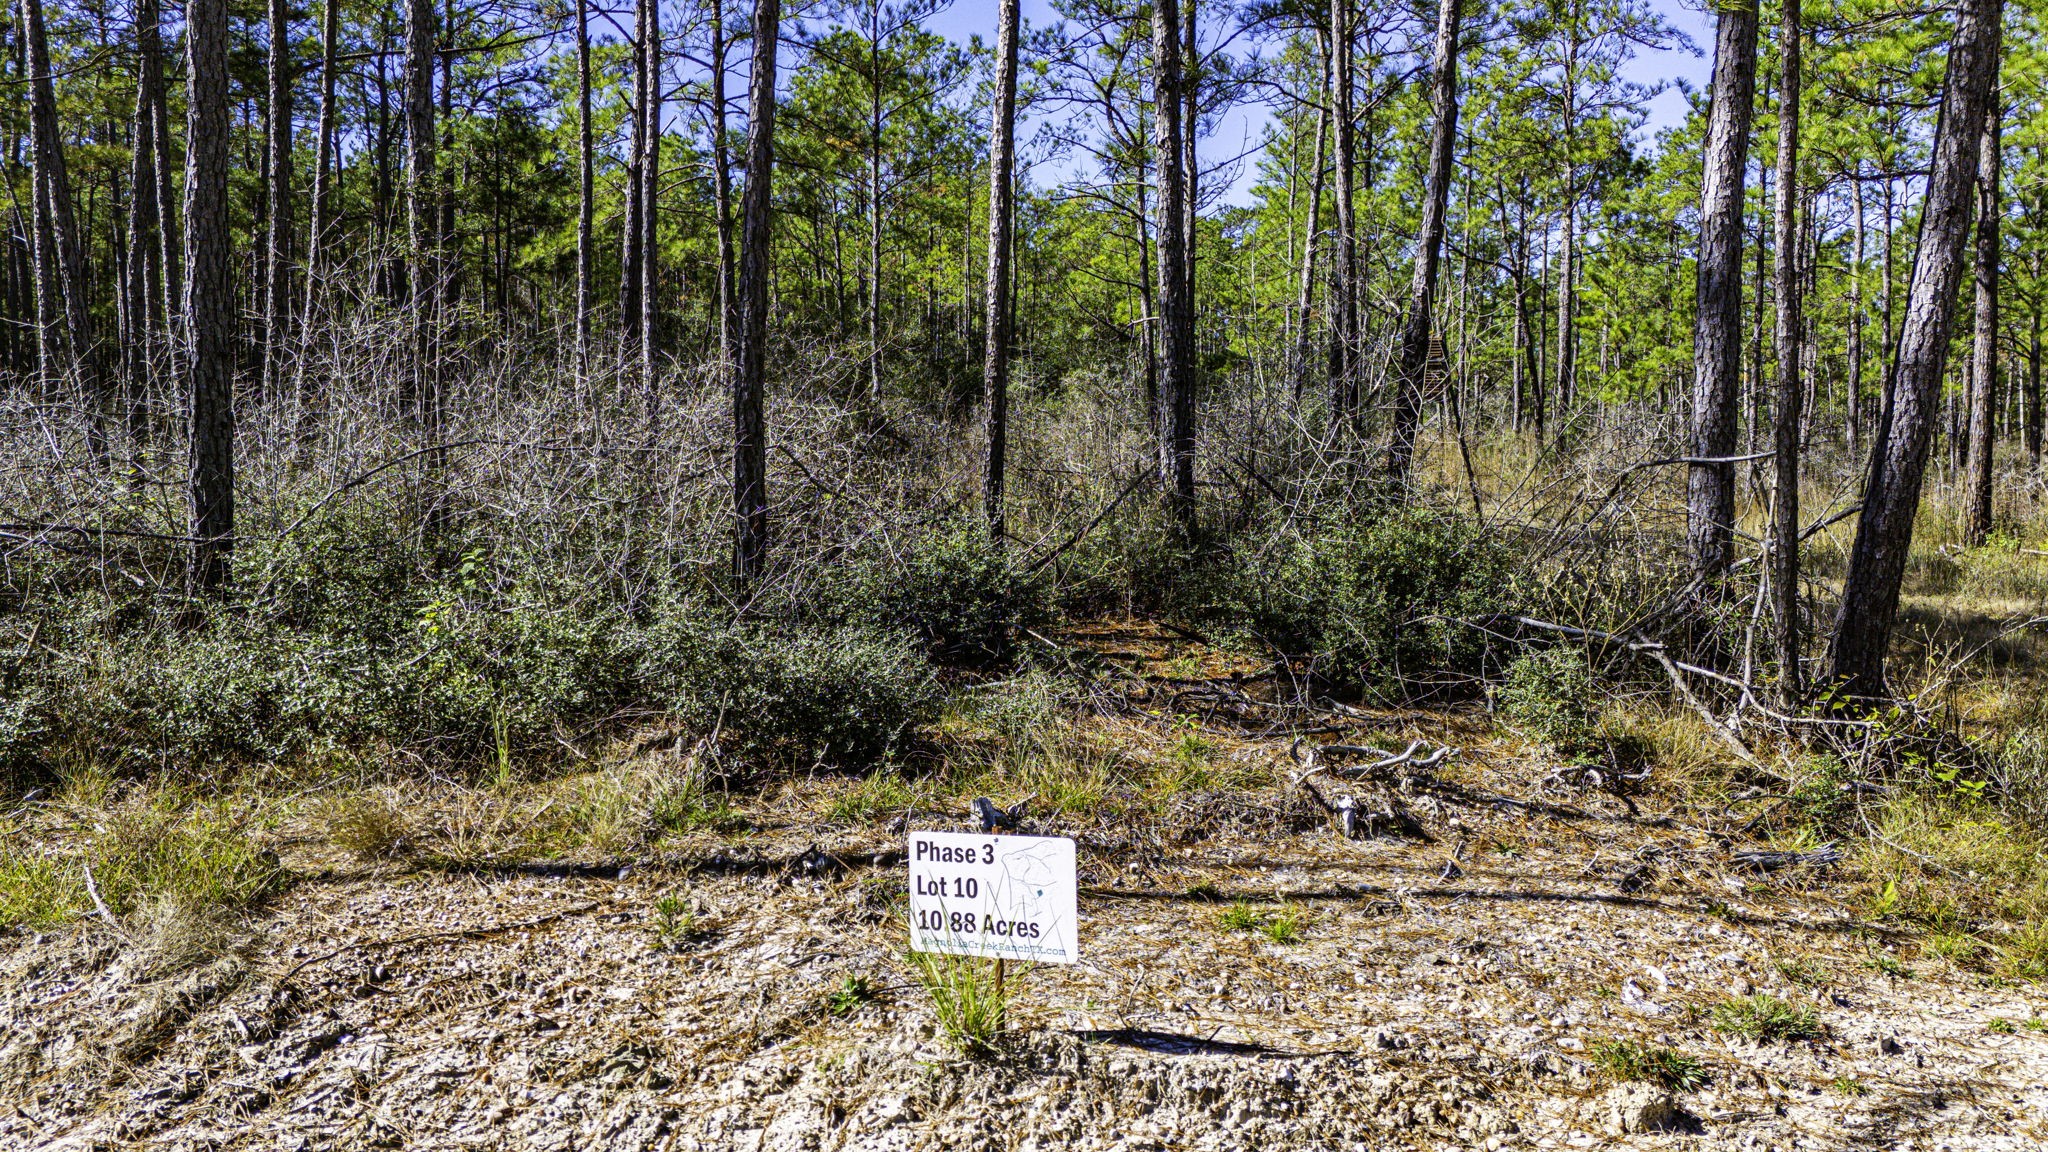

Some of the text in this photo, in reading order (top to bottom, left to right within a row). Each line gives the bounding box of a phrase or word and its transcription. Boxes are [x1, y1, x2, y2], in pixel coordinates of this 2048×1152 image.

[916, 841, 994, 865] Phase 3
[917, 875, 978, 899] Lot 10
[918, 910, 1040, 938] 1088 Acres
